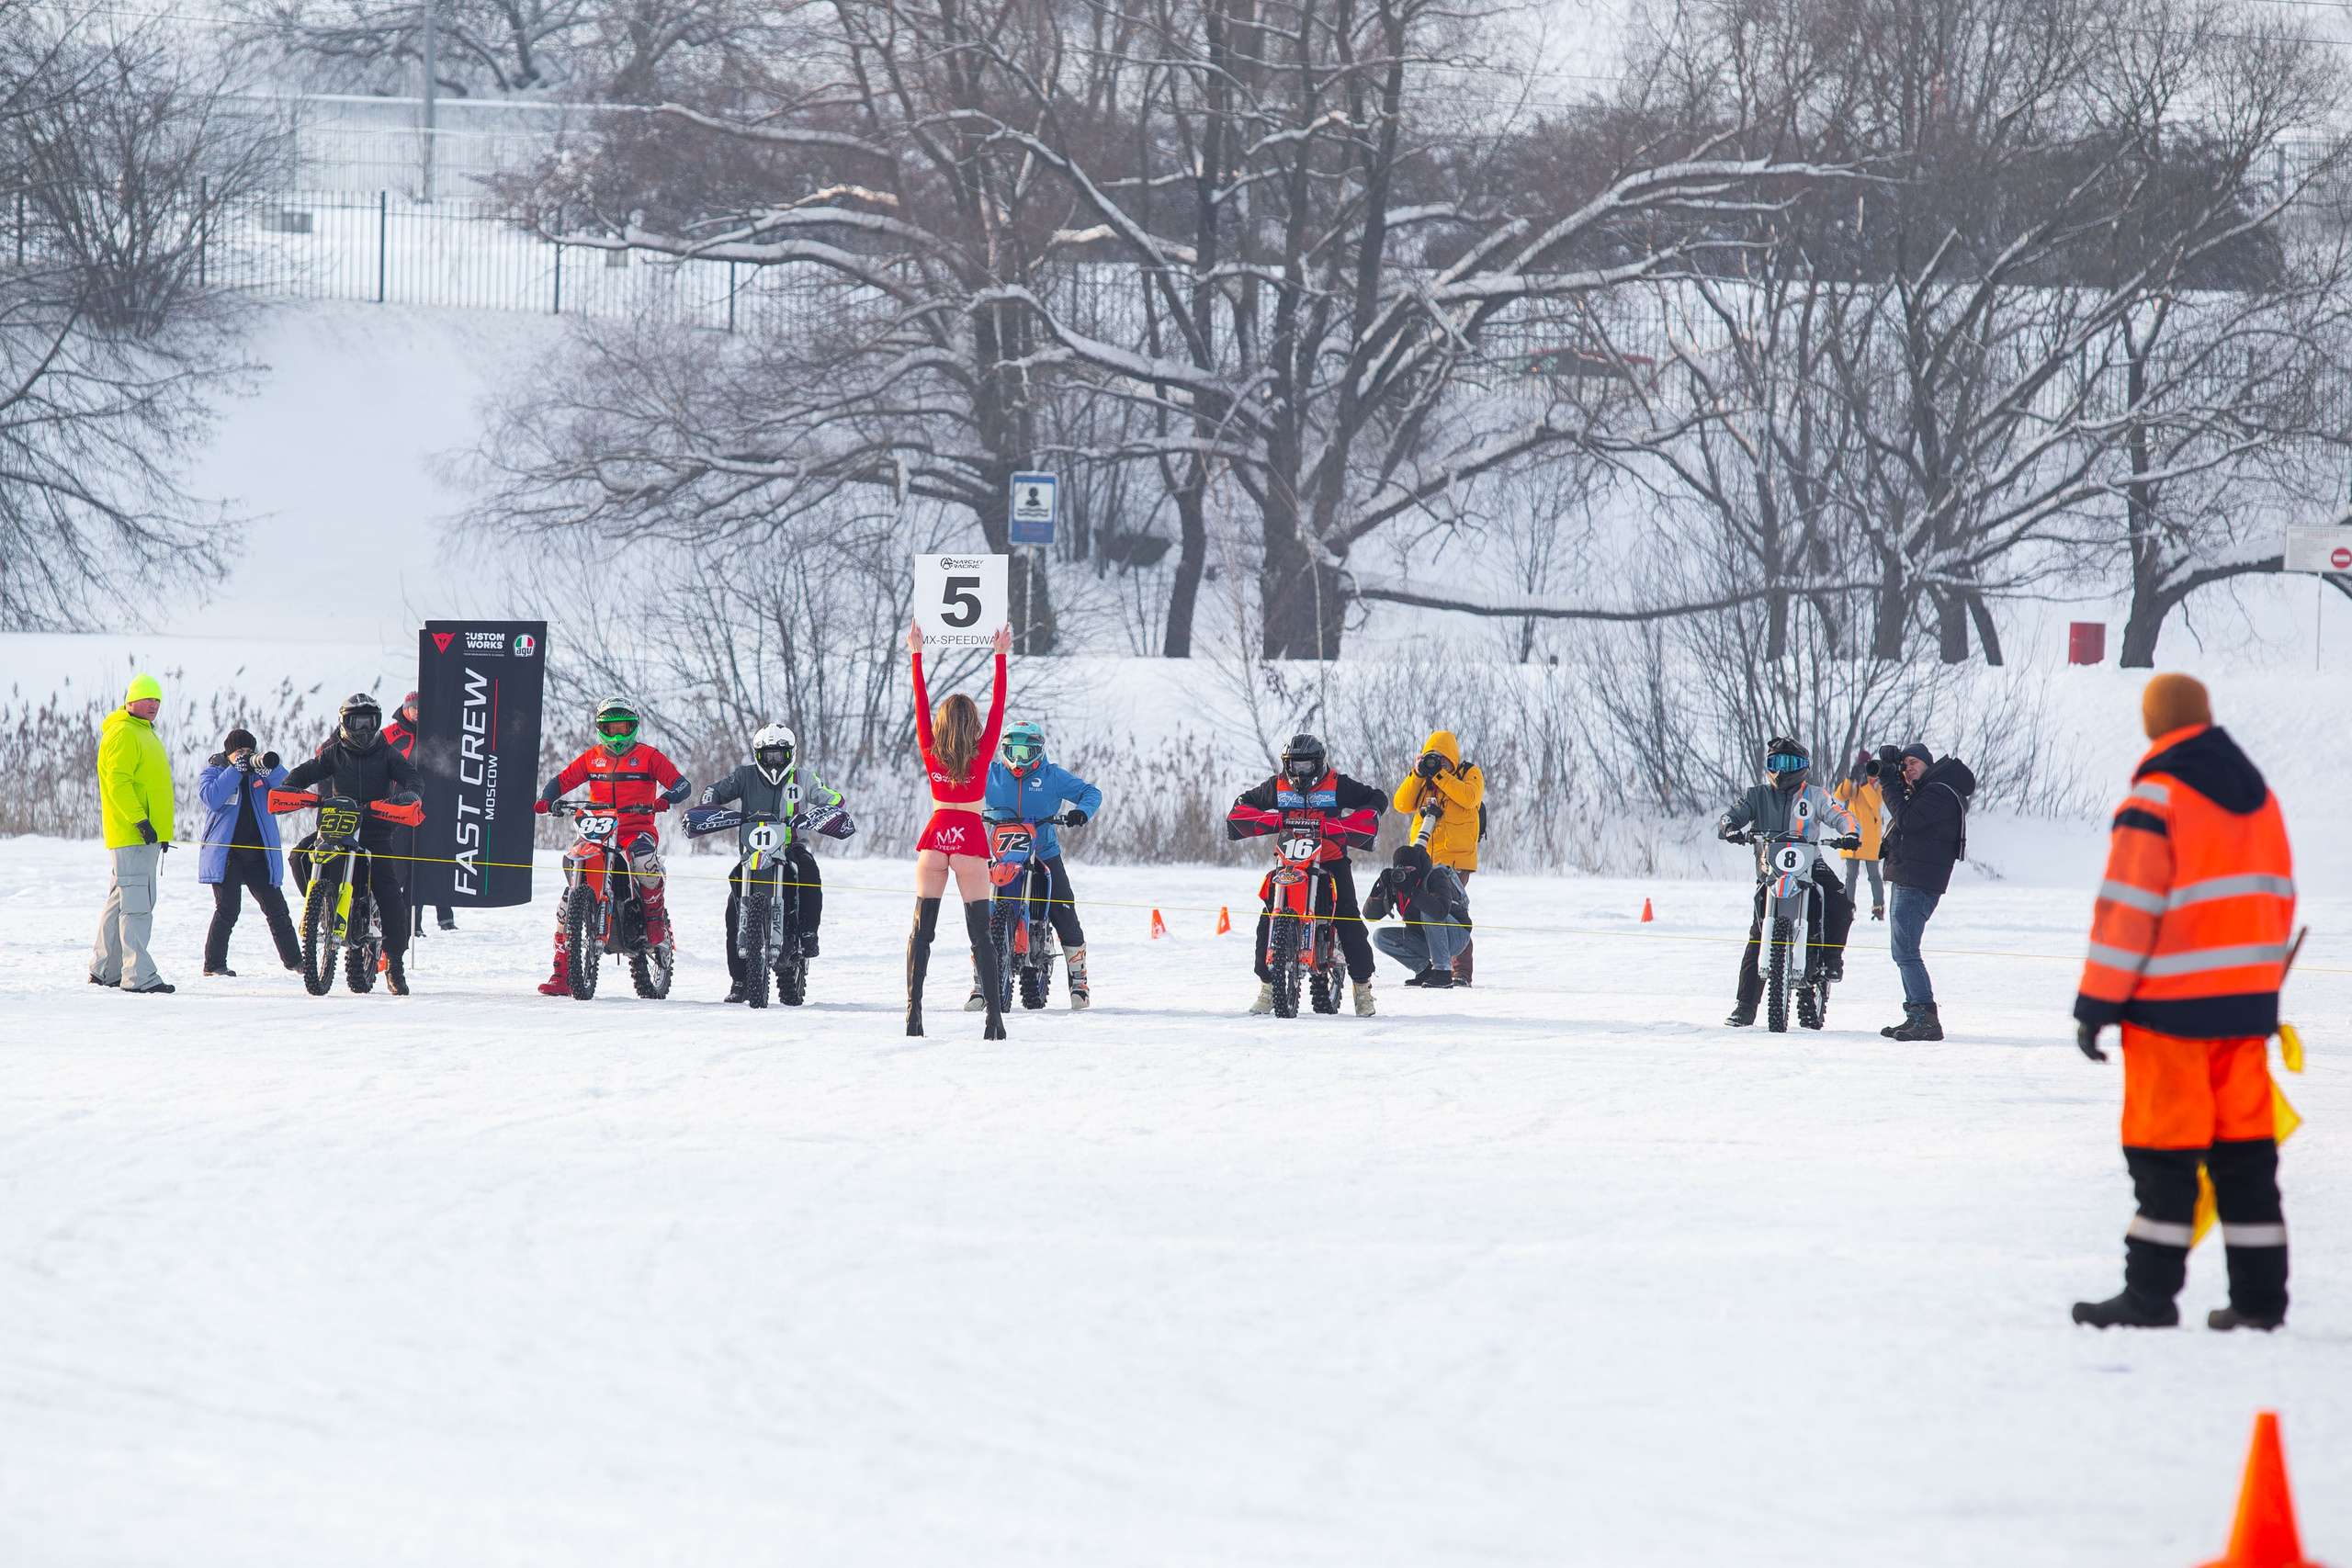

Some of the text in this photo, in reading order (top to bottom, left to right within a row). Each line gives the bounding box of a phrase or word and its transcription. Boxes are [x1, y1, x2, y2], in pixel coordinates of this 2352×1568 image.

[940, 577, 982, 627] 5
[467, 641, 503, 649] WORKS
[922, 636, 996, 645] MX-SPEEDWA
[516, 647, 533, 657] agv
[454, 667, 488, 896] FAST CREW
[484, 754, 498, 820] MOSCOW
[787, 786, 798, 799] 11
[1288, 808, 1325, 819] KTM
[1799, 802, 1808, 817] 8
[320, 813, 357, 835] 36
[578, 817, 614, 834] 93
[753, 830, 772, 846] 11
[936, 826, 966, 845] MX
[997, 832, 1033, 853] 72
[1282, 839, 1314, 859] 16
[1784, 851, 1796, 868] 8
